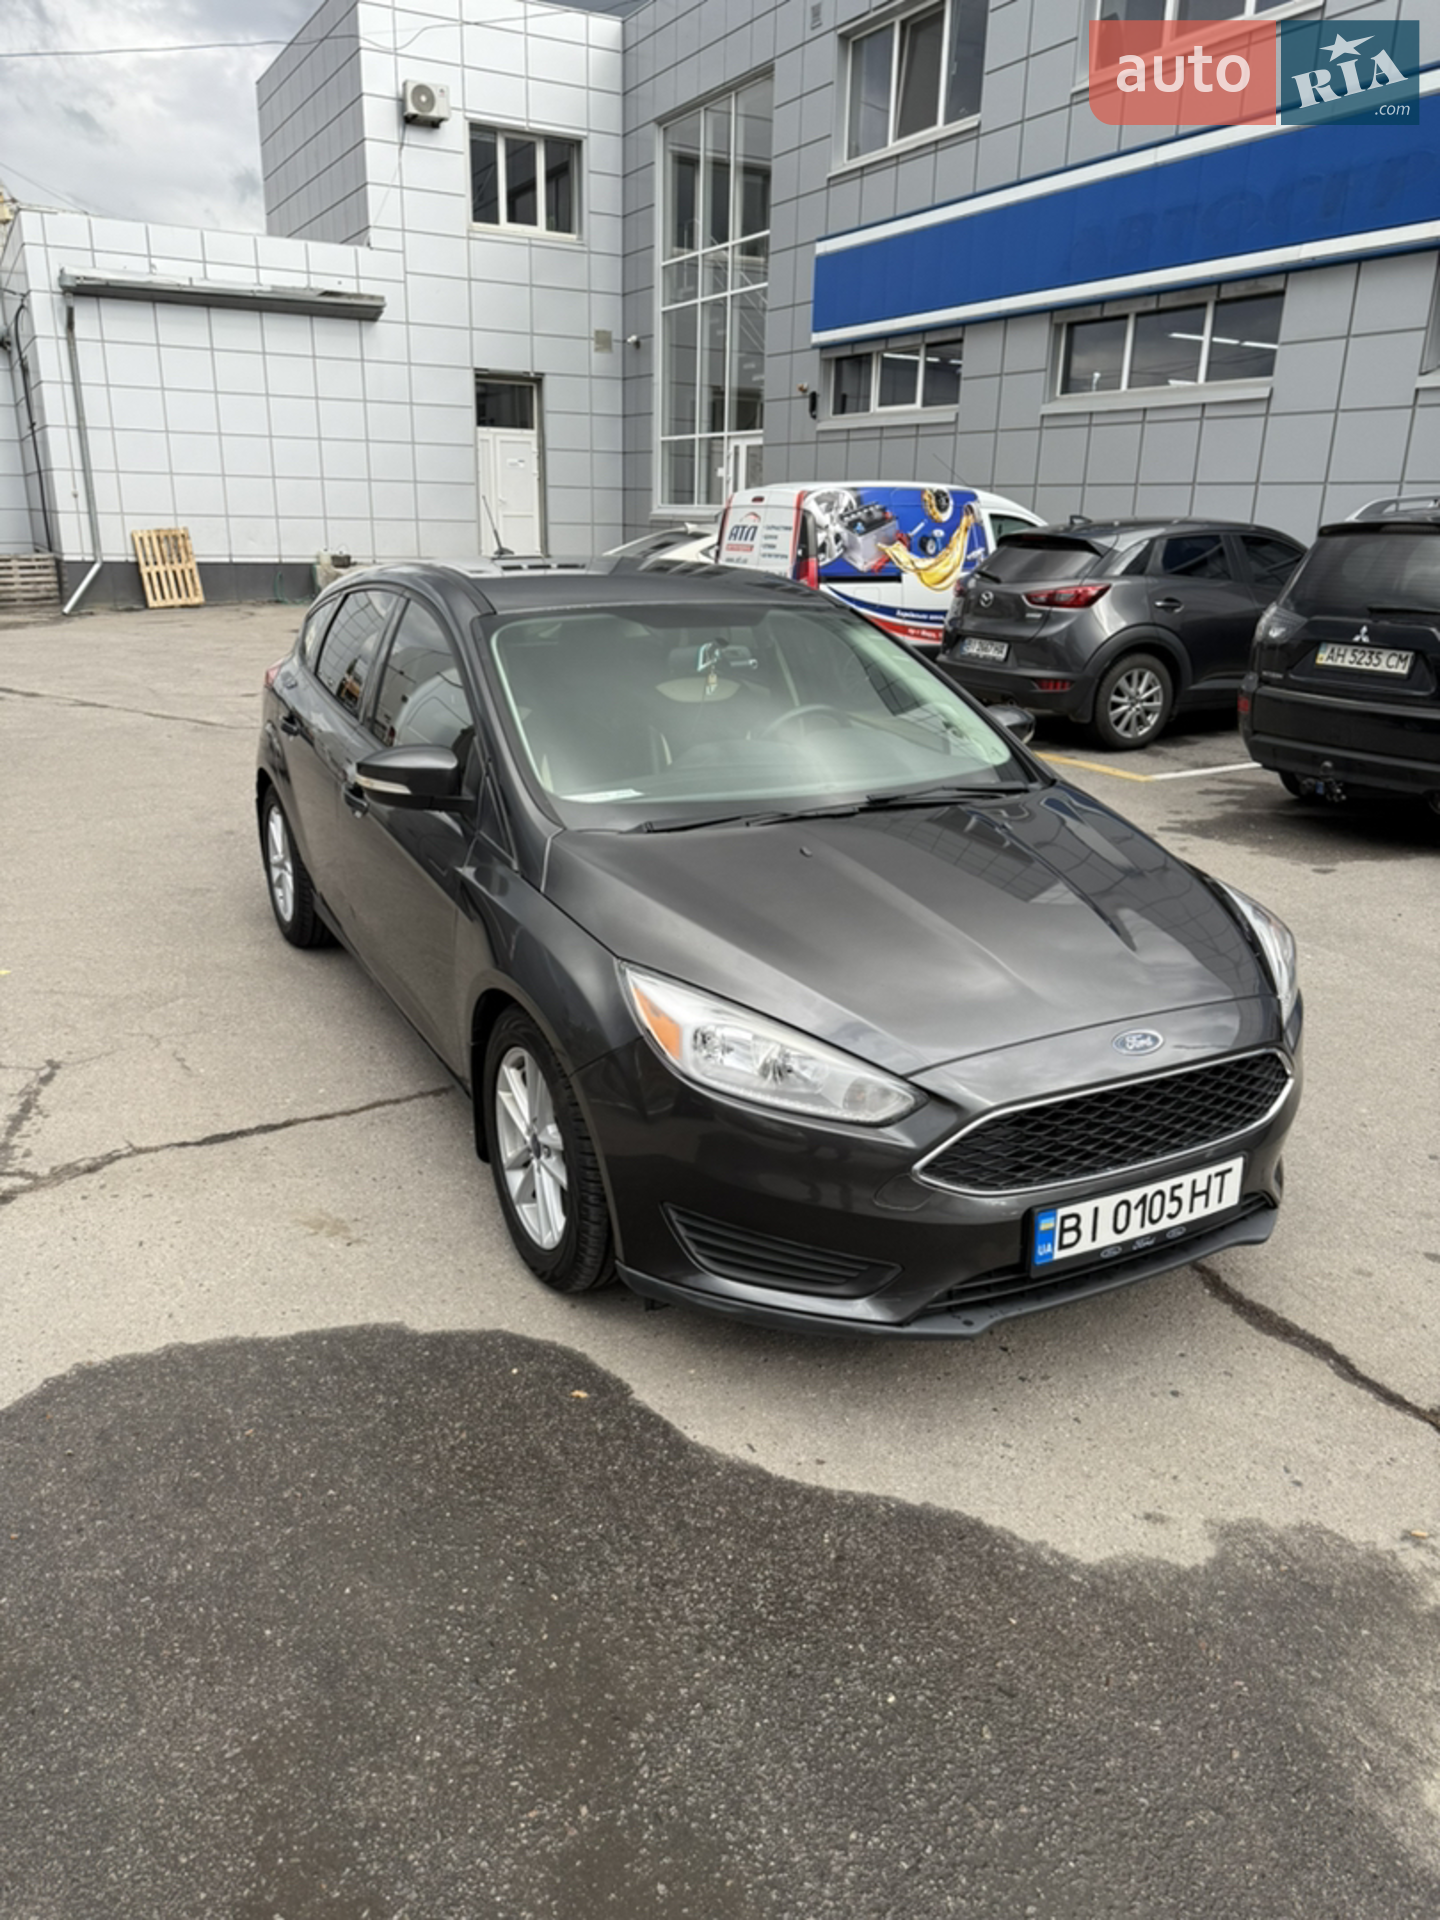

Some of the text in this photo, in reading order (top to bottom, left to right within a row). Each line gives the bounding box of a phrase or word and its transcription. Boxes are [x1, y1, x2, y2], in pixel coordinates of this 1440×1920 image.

[1325, 647, 1410, 671] AH 5235 CM
[1057, 1168, 1233, 1251] BI 0105 HT
[1037, 1242, 1053, 1256] UA
